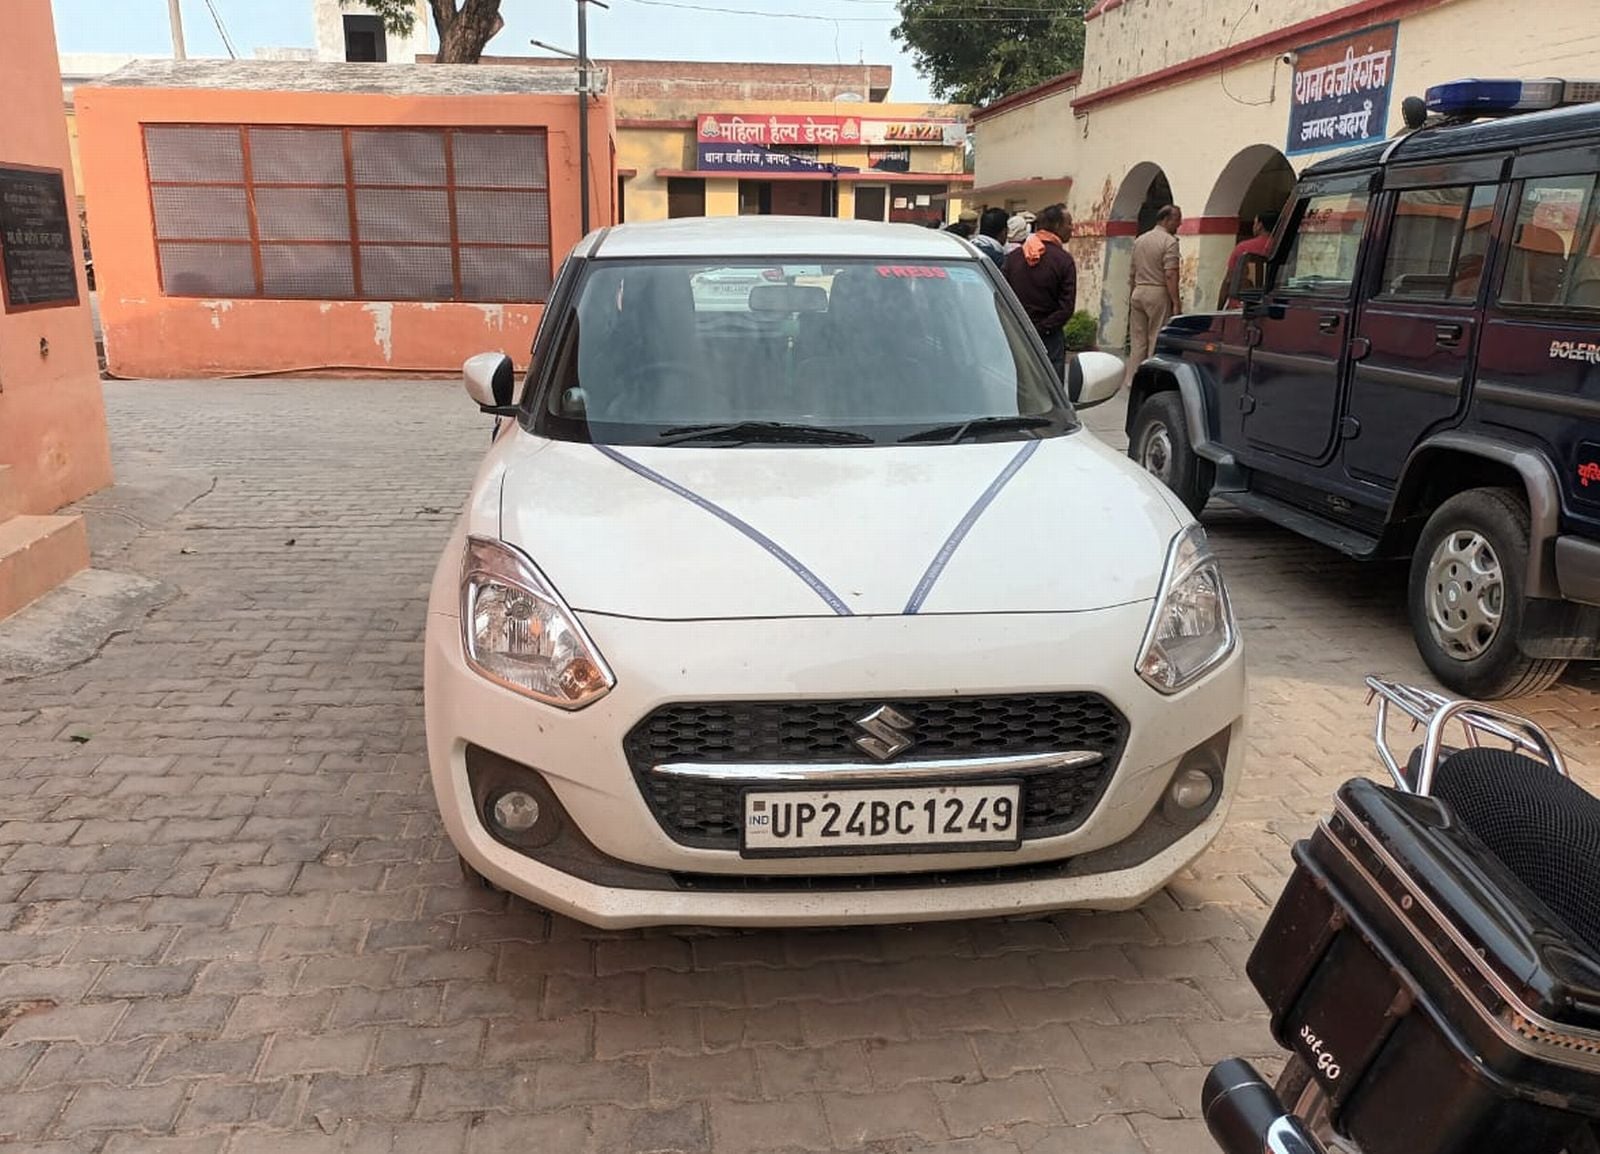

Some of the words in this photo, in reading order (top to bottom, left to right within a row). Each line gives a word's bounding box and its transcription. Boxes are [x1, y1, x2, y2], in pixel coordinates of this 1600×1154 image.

[1295, 66, 1327, 105] थाना
[719, 116, 766, 144] महिला
[768, 116, 800, 144] हैल्प
[802, 116, 841, 143] डेस्क
[885, 125, 943, 140] PLAZA
[705, 152, 724, 163] थाना
[765, 153, 790, 165] जनपद
[876, 265, 945, 278] PRESS
[749, 815, 769, 825] IND
[771, 797, 1012, 838] UP24BC1249
